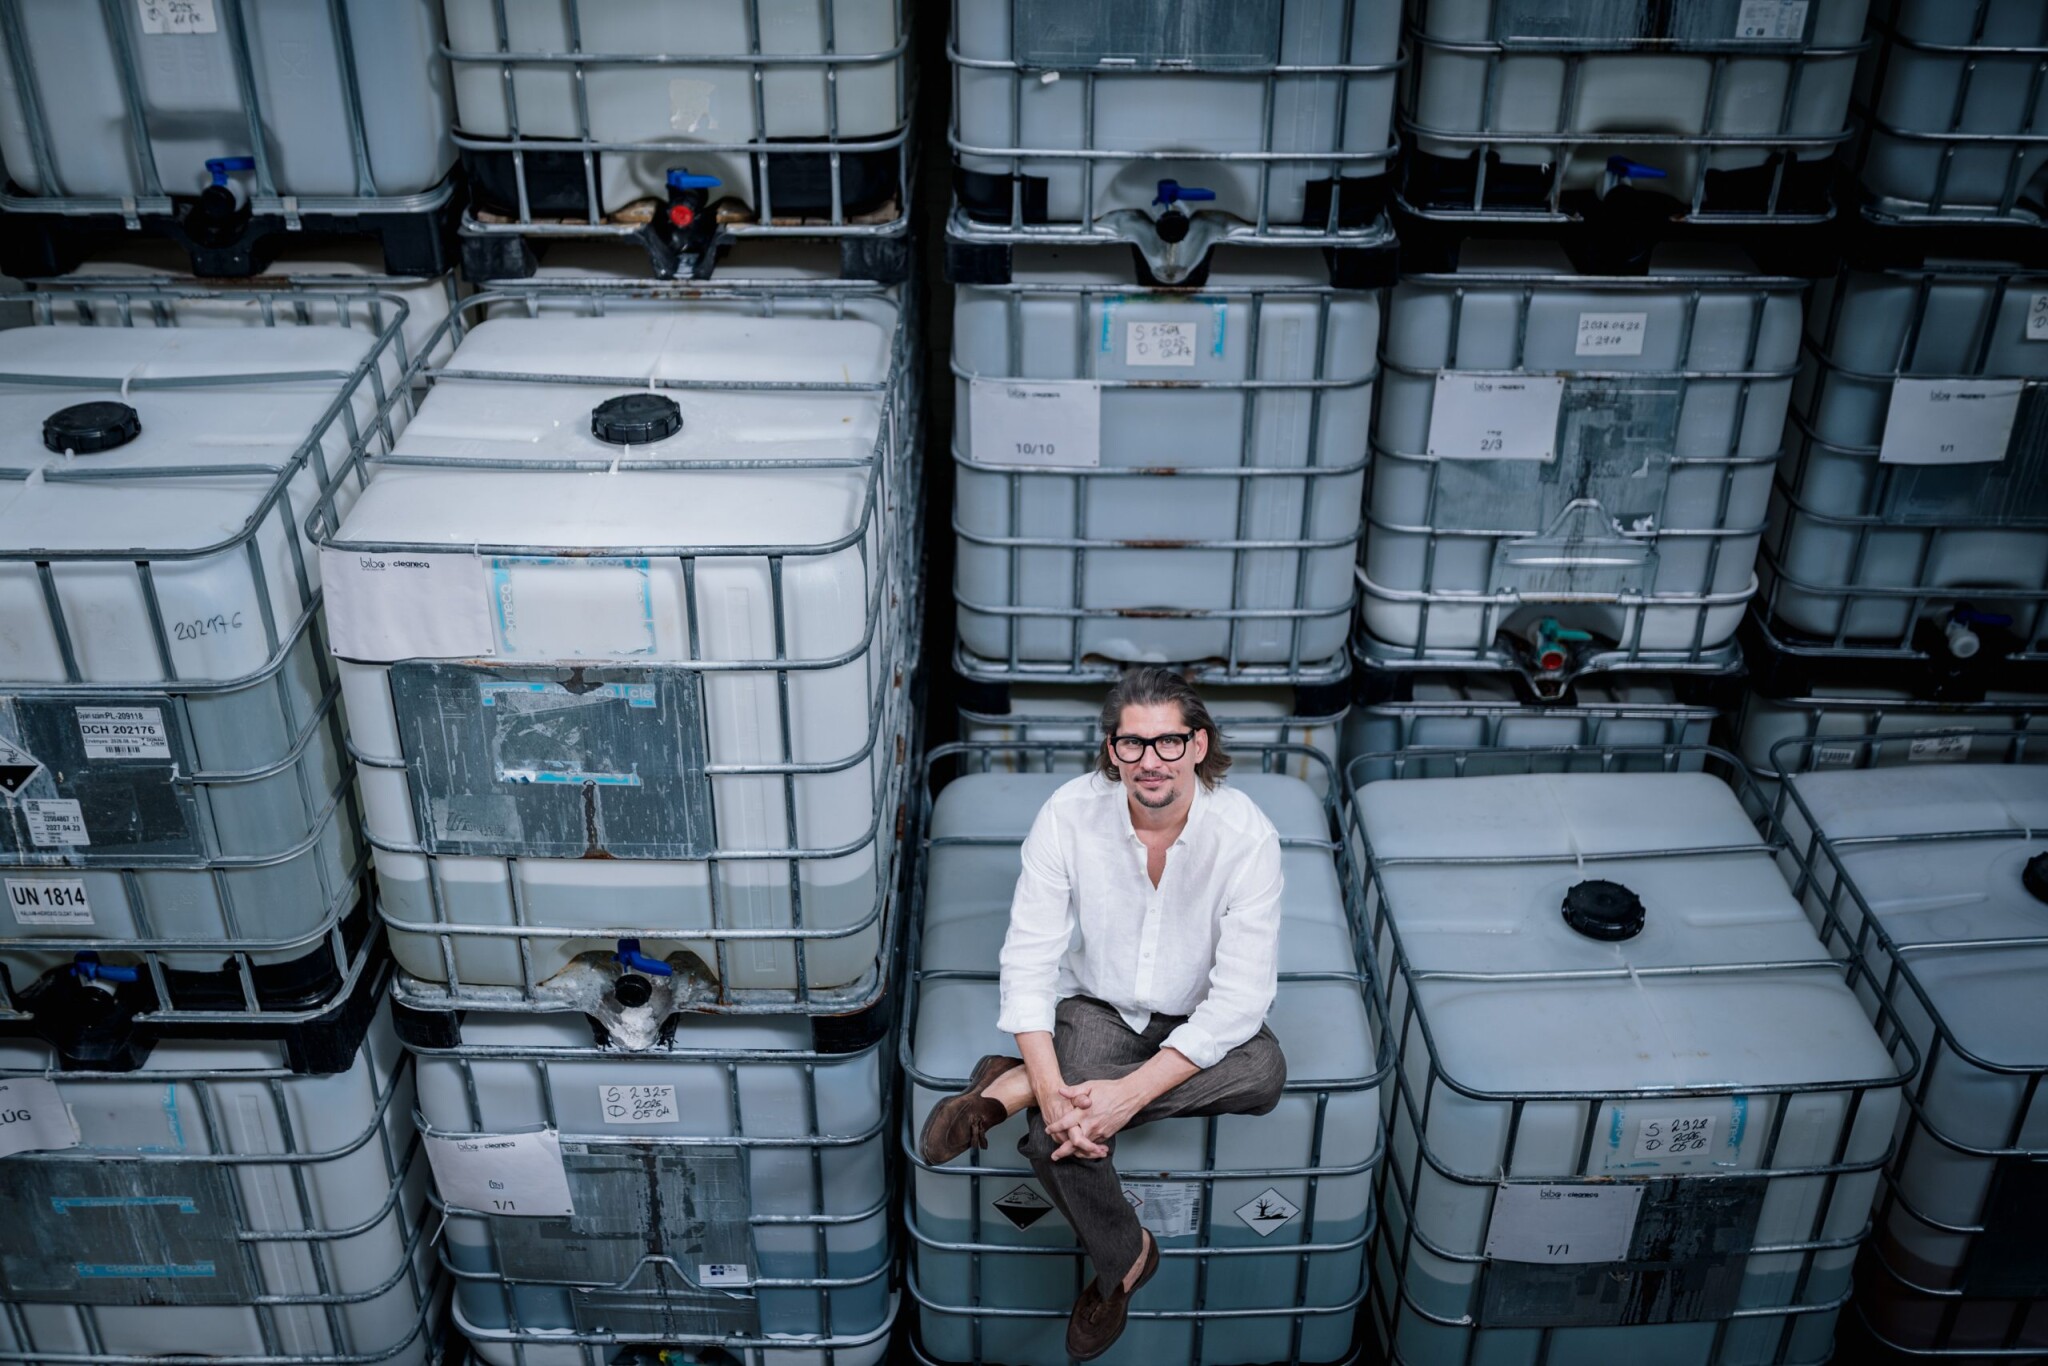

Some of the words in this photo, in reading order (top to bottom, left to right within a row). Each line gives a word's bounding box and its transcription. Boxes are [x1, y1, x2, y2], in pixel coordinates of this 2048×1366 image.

[1016, 443, 1055, 455] 10/10
[1481, 439, 1503, 451] 2/3
[174, 611, 242, 640] 202176
[82, 725, 110, 735] DCH
[113, 725, 155, 735] 202176
[12, 887, 40, 906] UN
[44, 887, 85, 906] 1814
[629, 1087, 672, 1100] 2925
[493, 1200, 516, 1210] 1/1
[1546, 1244, 1570, 1255] 1/1
